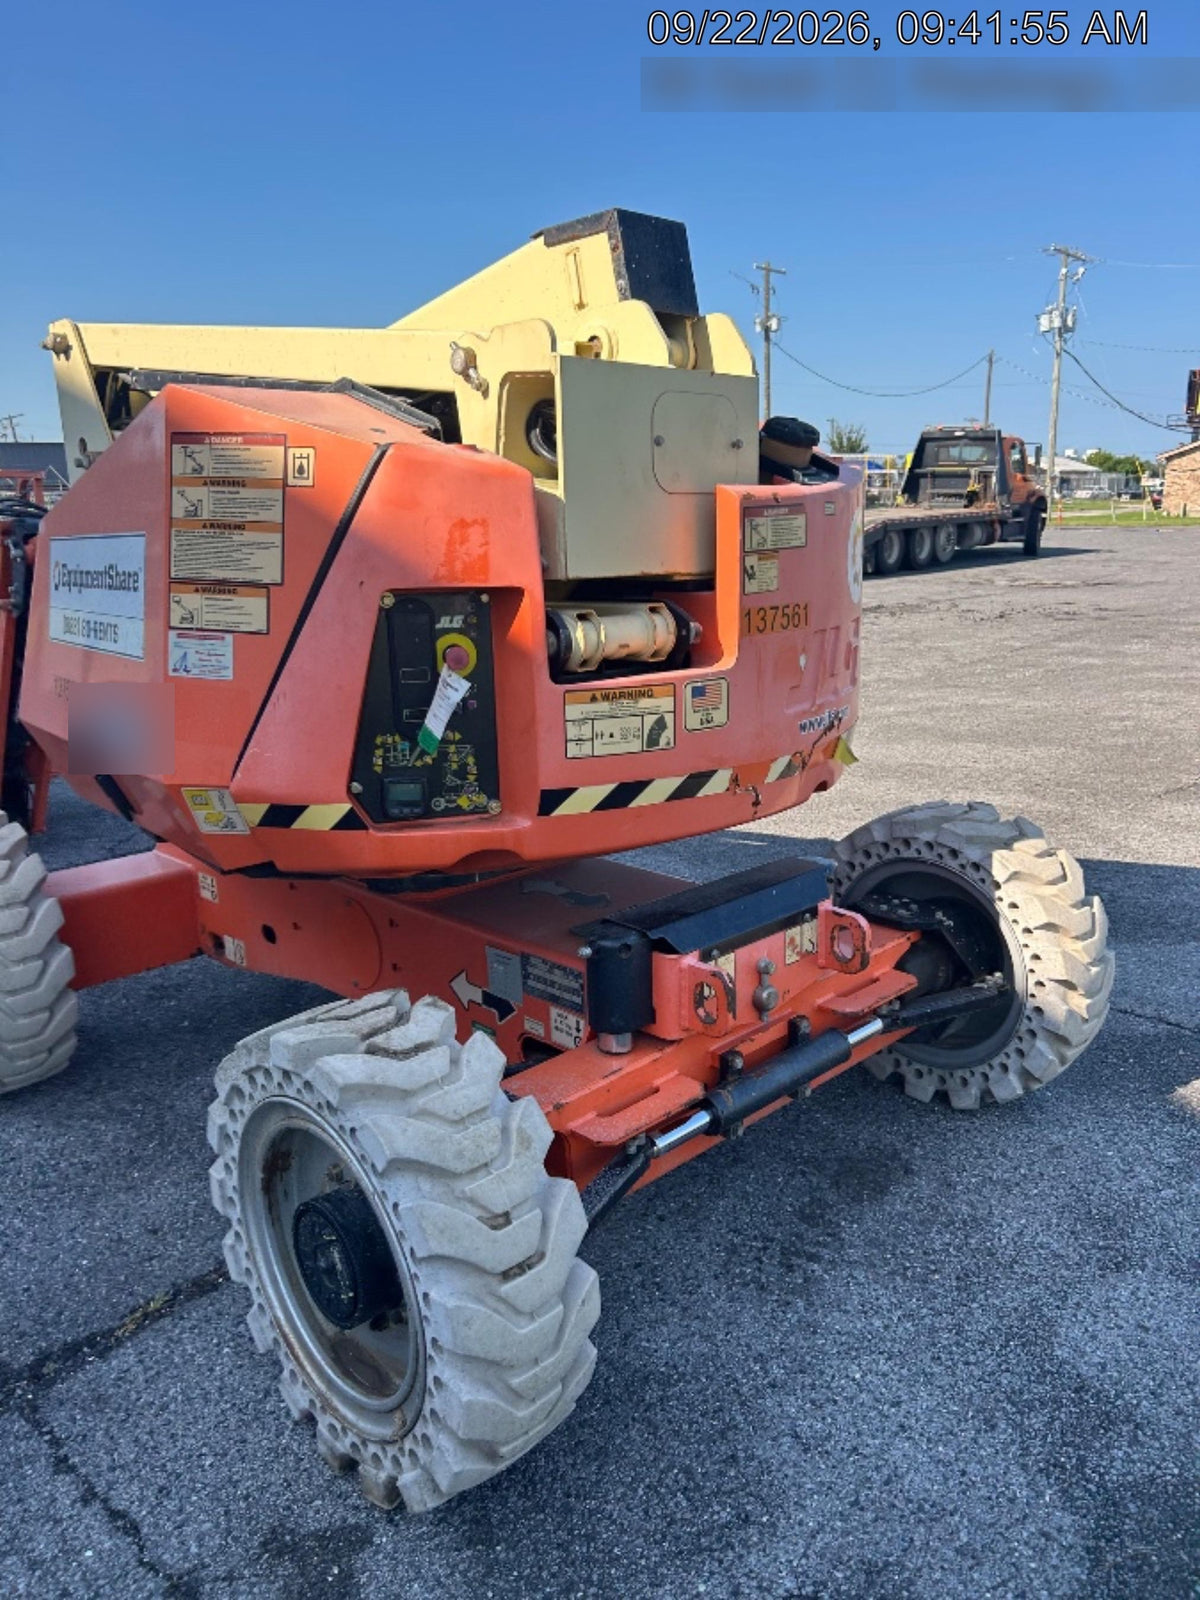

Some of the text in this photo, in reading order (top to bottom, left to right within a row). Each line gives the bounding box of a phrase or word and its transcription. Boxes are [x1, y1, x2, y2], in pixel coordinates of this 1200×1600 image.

[61, 563, 140, 594] EquipmentShare
[435, 615, 464, 629] JLG
[744, 602, 809, 634] 137561
[601, 688, 654, 701] WARNING
